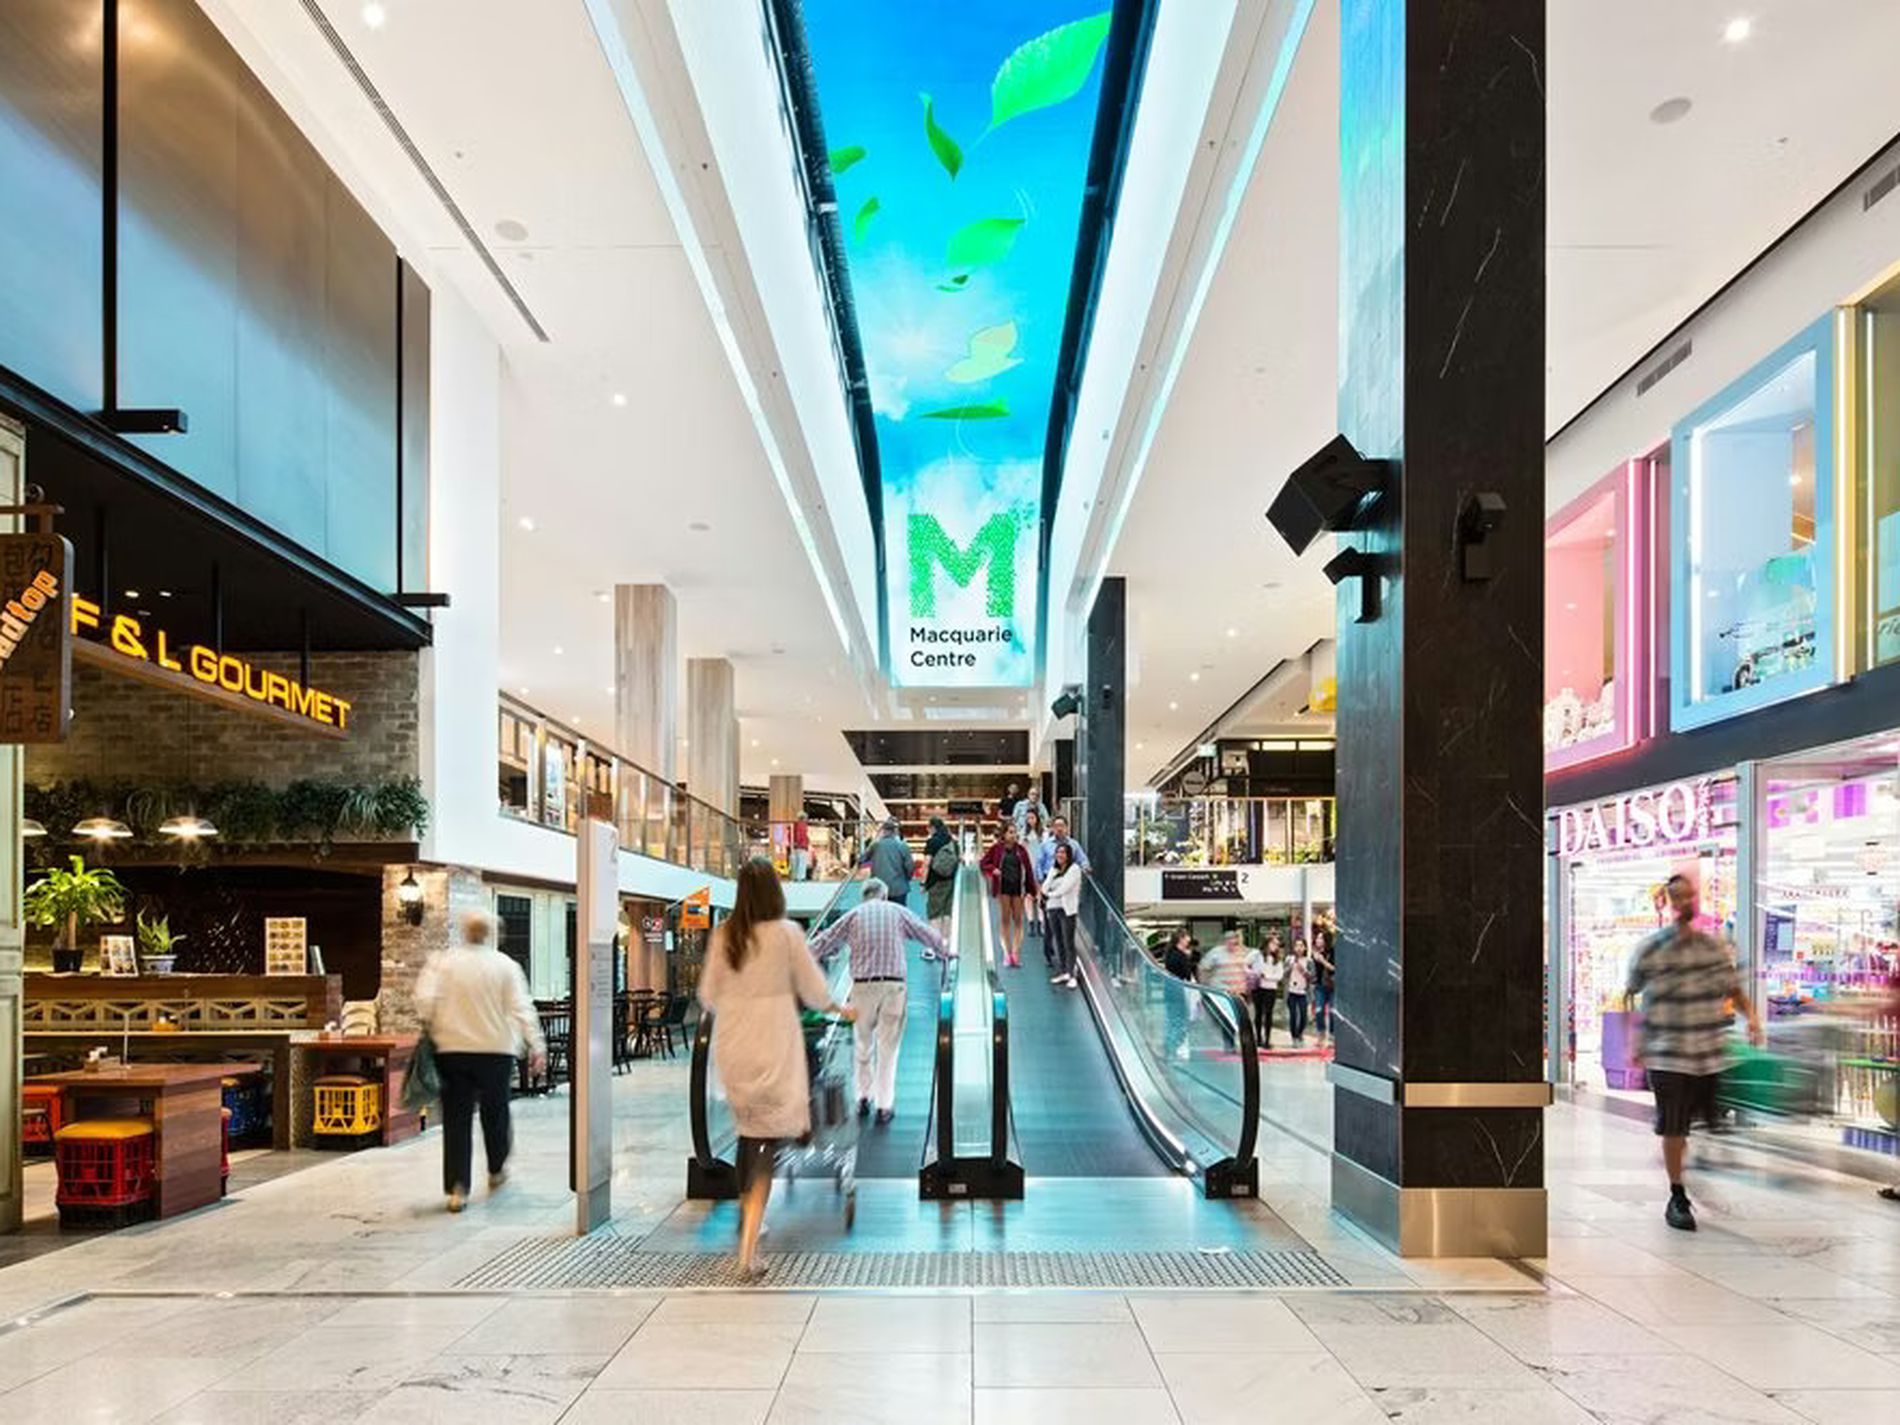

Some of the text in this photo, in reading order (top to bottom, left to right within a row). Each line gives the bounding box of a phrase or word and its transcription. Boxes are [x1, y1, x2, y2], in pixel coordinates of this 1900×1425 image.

[908, 514, 1015, 618] M
[910, 626, 1013, 645] Macquarie
[70, 592, 350, 729] F & L GOURMET
[910, 651, 976, 667] Centre
[1556, 784, 1695, 858] DAISO
[1241, 872, 1249, 884] 2
